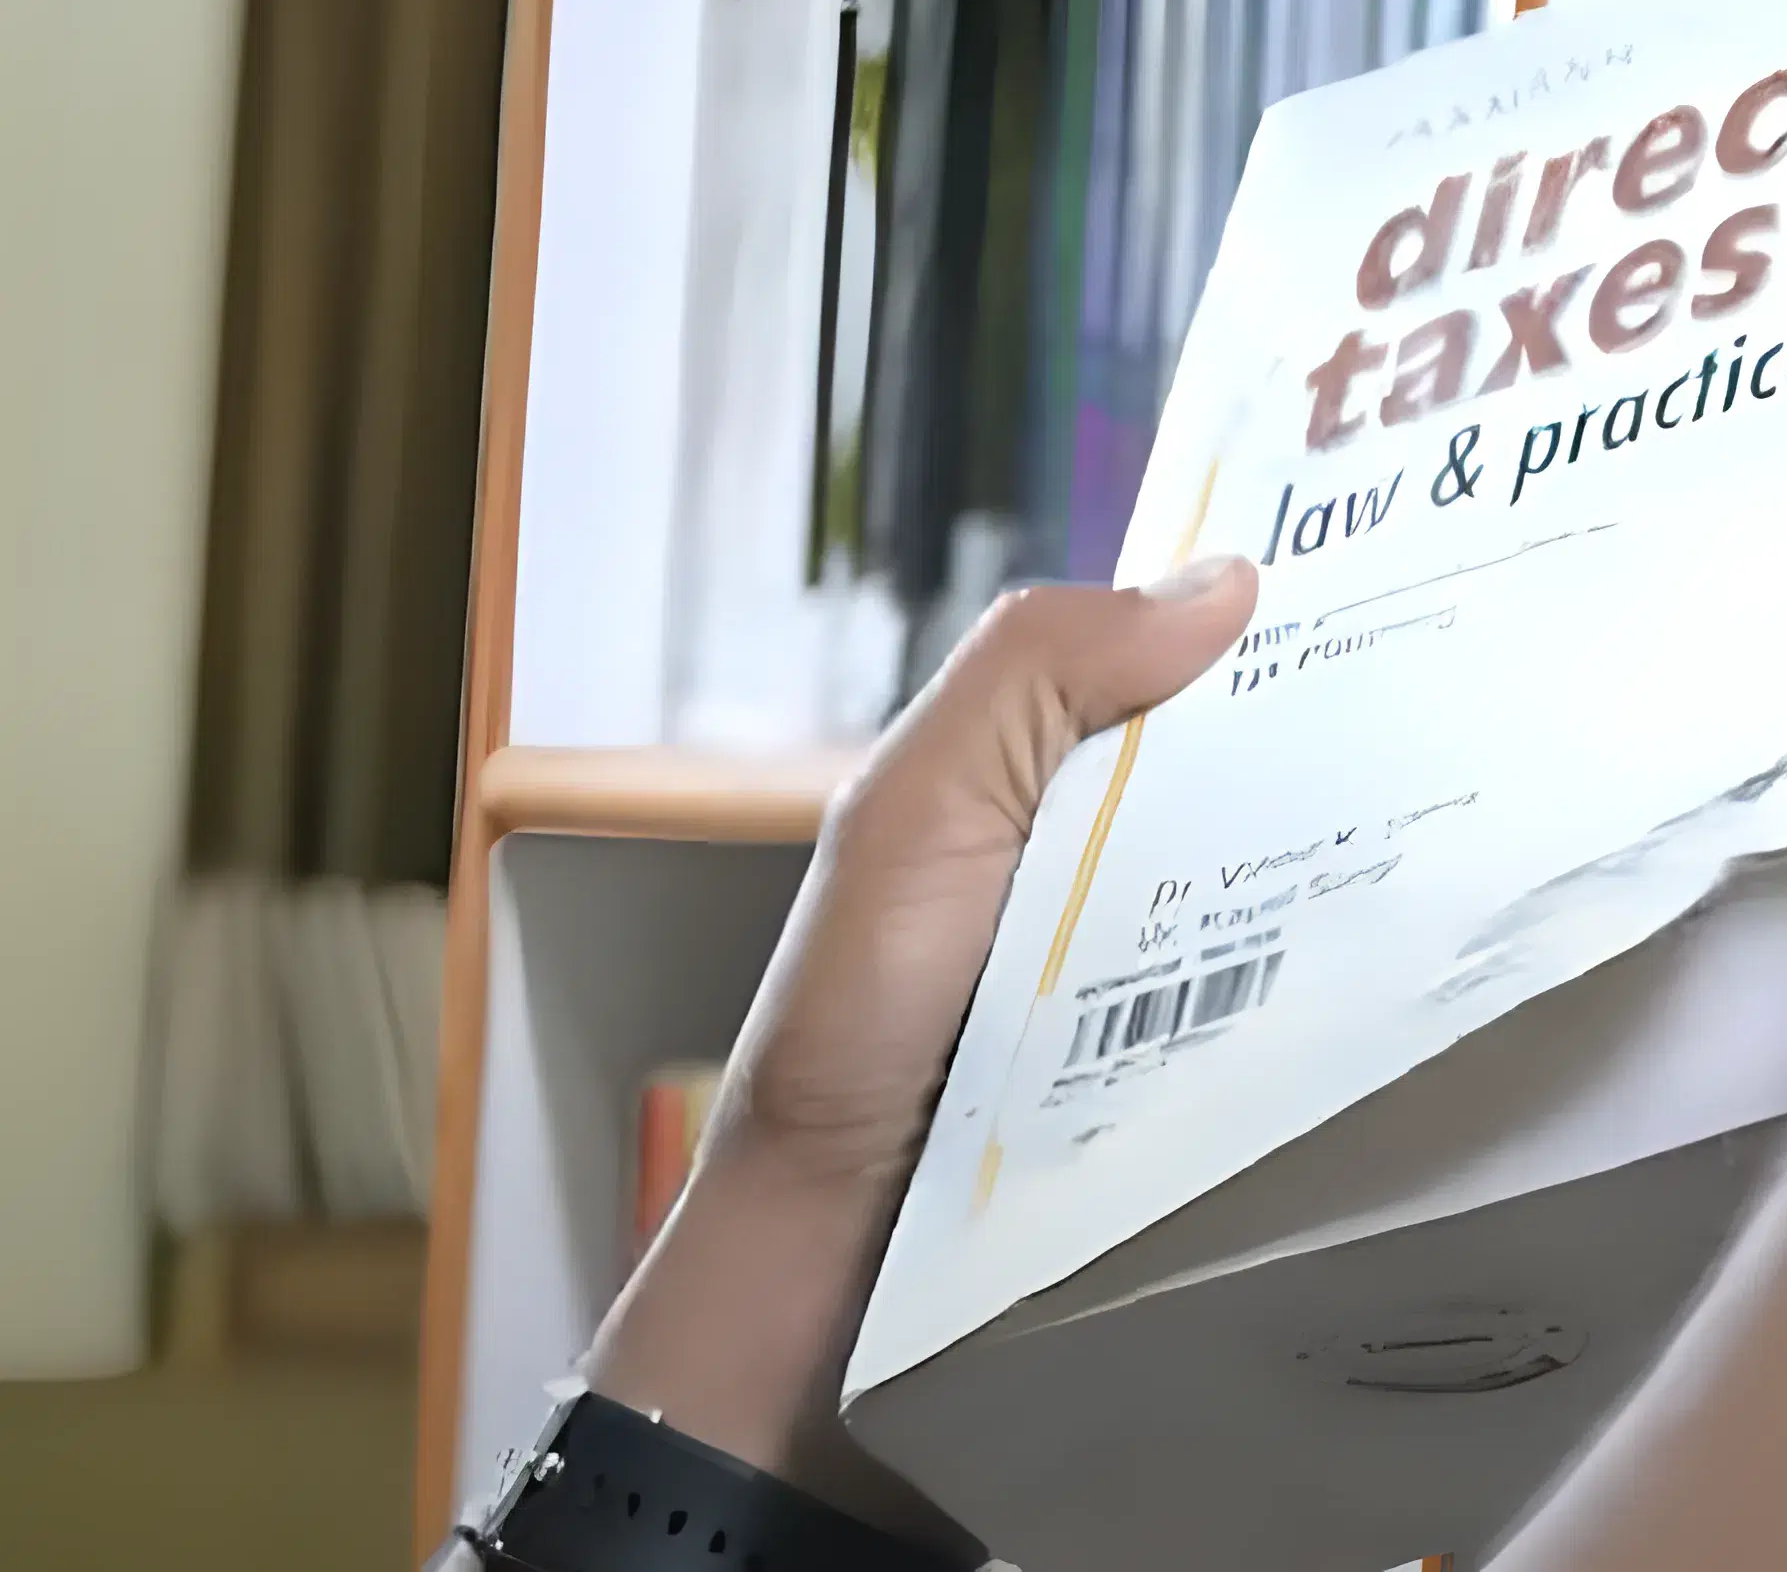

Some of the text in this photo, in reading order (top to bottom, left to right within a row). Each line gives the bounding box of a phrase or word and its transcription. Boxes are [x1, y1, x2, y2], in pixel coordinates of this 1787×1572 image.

[1304, 201, 1782, 456] taxes
[1259, 468, 1405, 568] law
[1429, 424, 1485, 508] &
